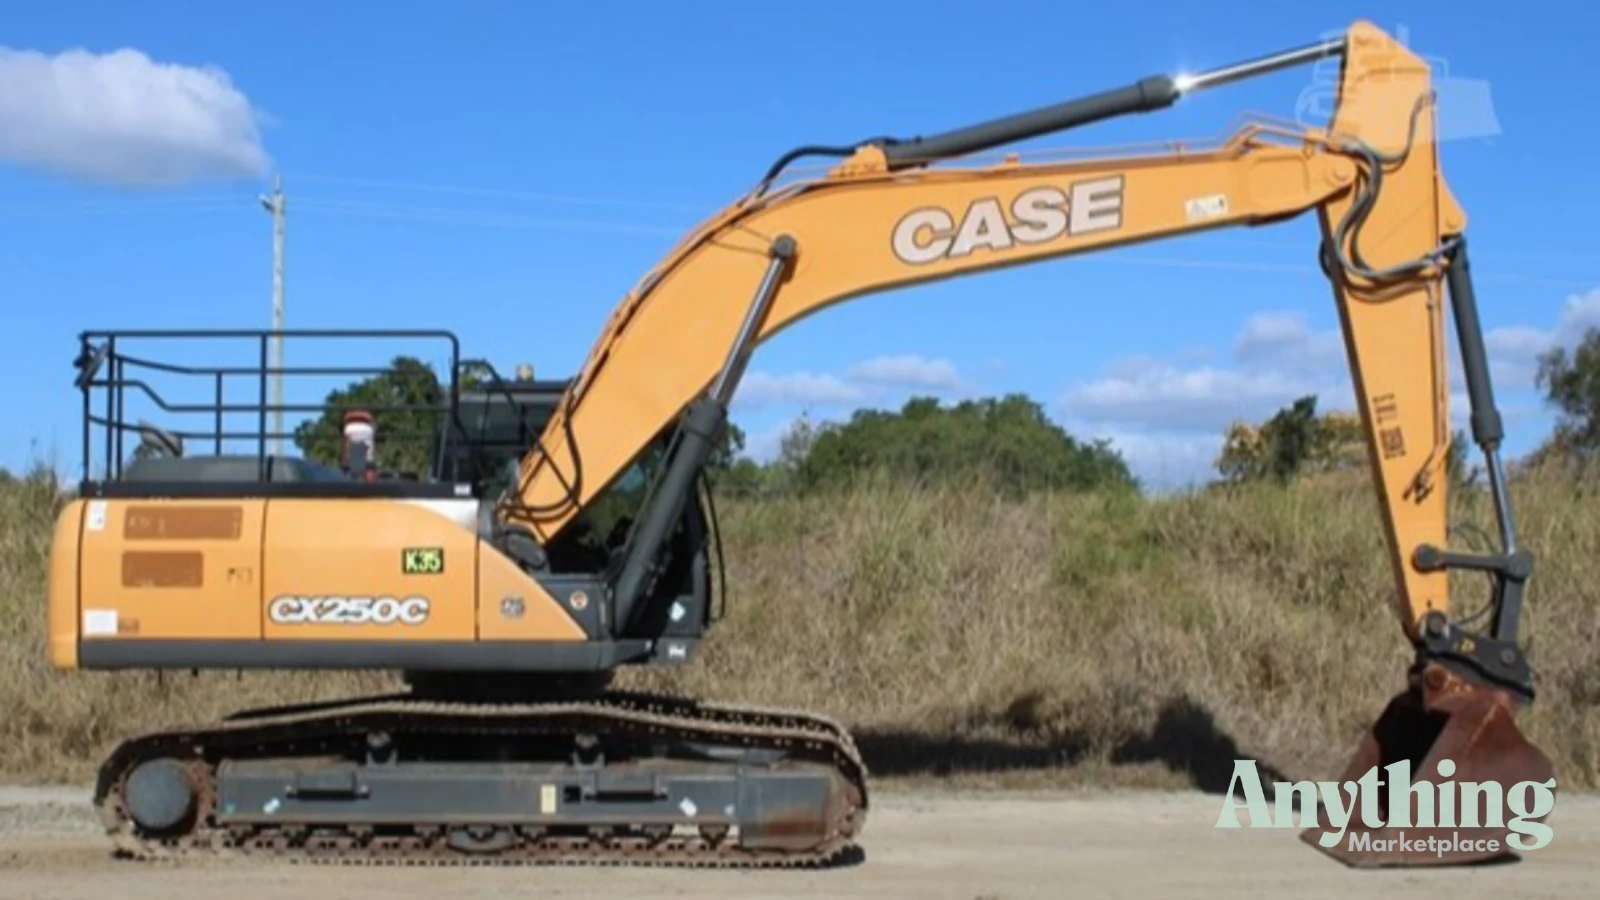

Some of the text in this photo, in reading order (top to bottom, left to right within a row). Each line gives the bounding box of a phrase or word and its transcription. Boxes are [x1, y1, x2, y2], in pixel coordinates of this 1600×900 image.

[891, 174, 1125, 267] CASE
[406, 548, 442, 572] K35
[268, 594, 430, 626] CX250C
